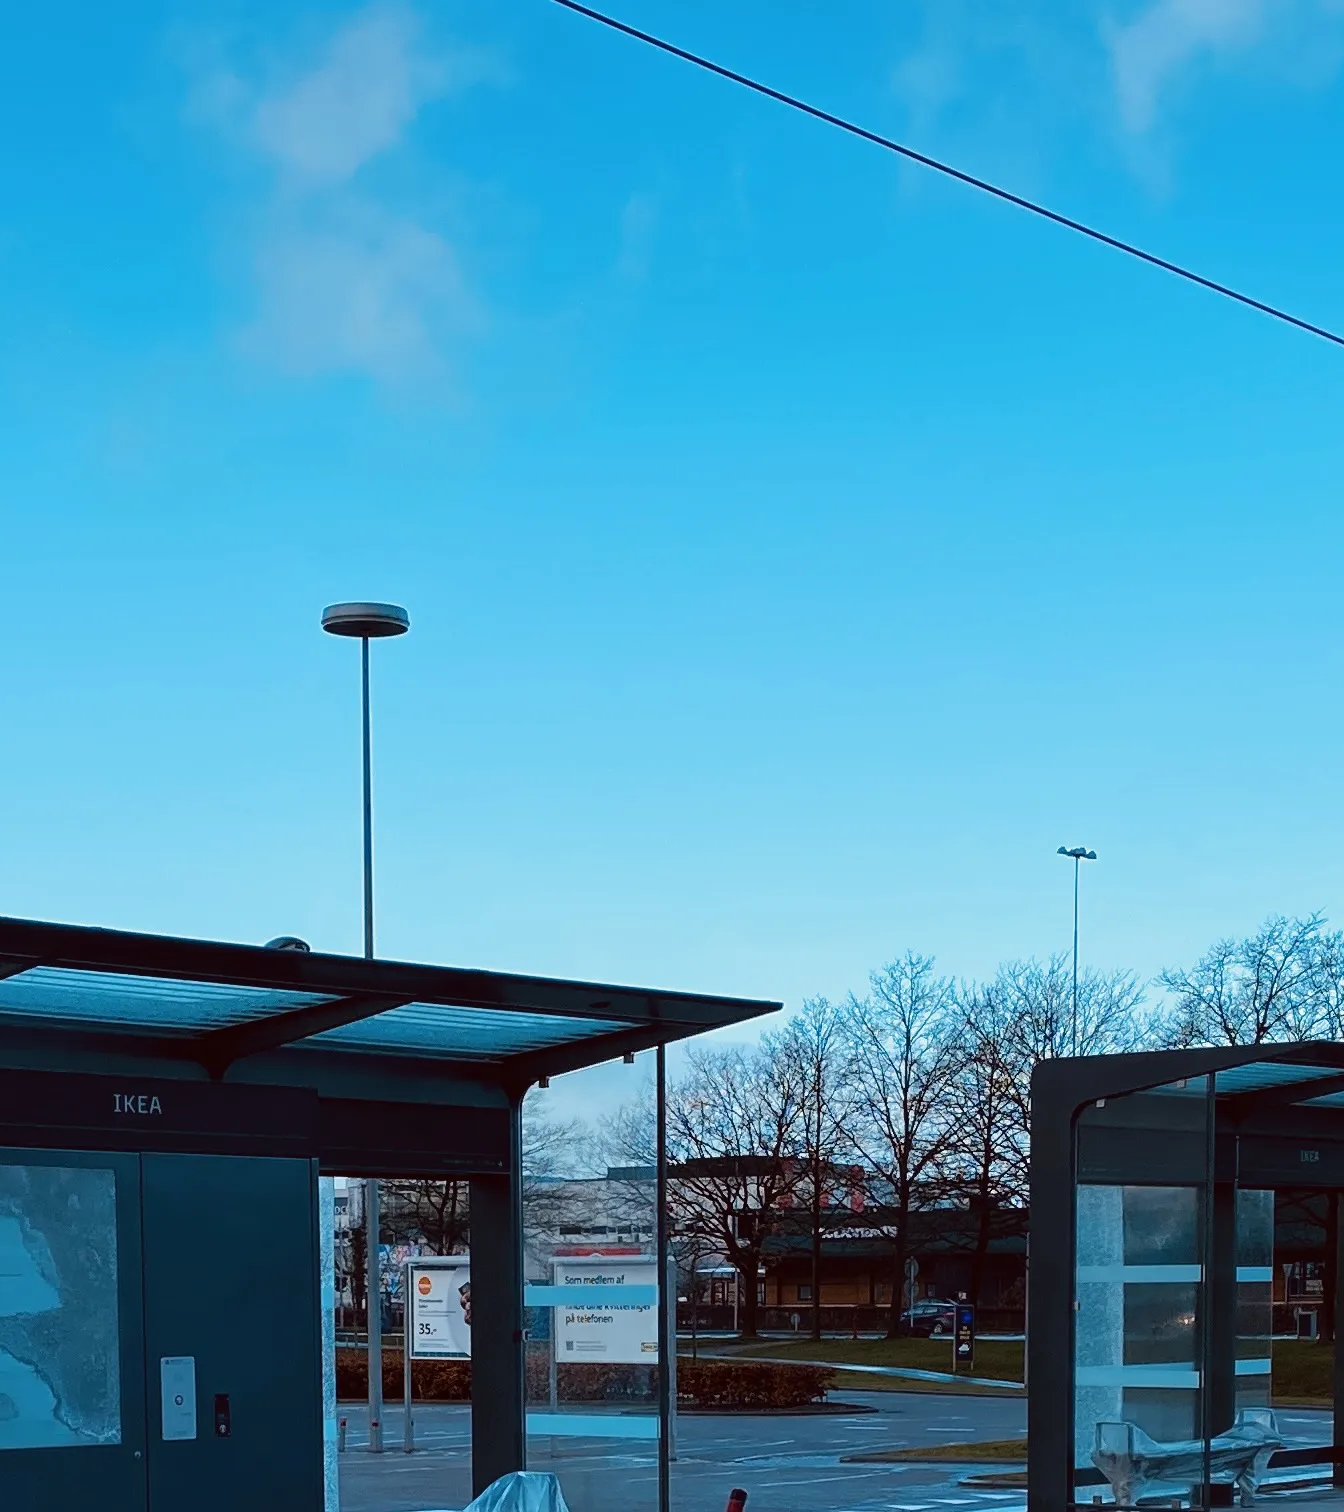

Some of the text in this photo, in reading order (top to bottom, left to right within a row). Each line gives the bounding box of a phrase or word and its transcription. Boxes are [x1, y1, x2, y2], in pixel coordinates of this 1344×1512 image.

[113, 1094, 162, 1114] IKEA
[565, 1275, 625, 1284] Som medlem af
[577, 1314, 614, 1324] telefonen
